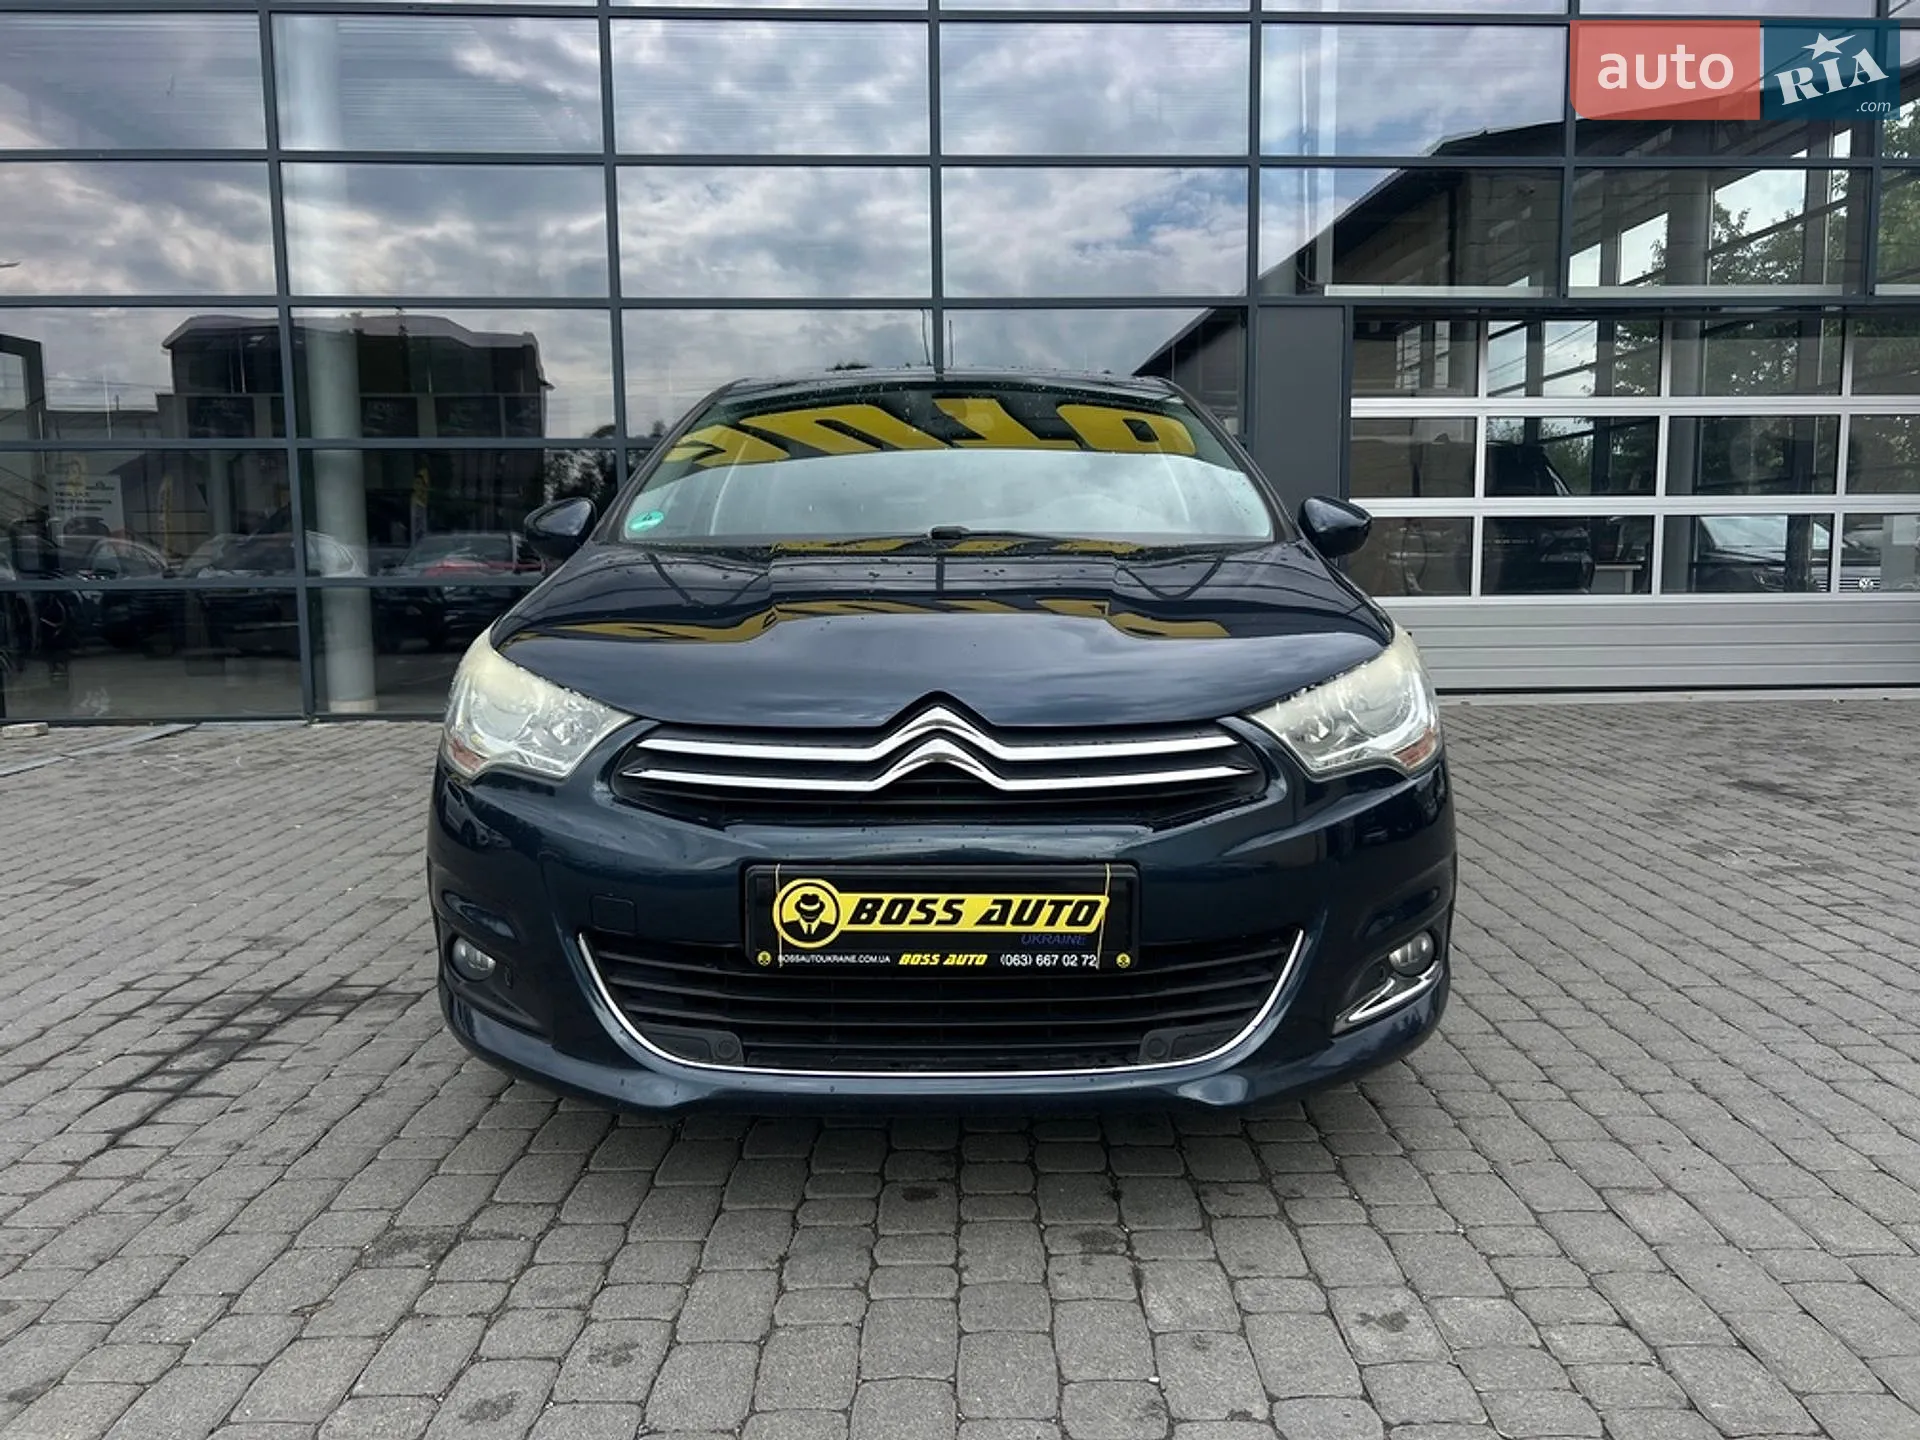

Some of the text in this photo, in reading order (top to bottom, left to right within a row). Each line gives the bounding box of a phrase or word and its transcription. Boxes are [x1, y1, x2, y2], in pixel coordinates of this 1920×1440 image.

[847, 897, 1102, 927] BOSS AUTO
[1020, 934, 1087, 945] UKRAINE
[899, 954, 940, 966] BOSS
[943, 954, 989, 966] AUTO
[1000, 953, 1032, 967] (063)
[1035, 954, 1059, 967] 667
[1062, 954, 1078, 967] 02
[1081, 954, 1097, 967] 72
